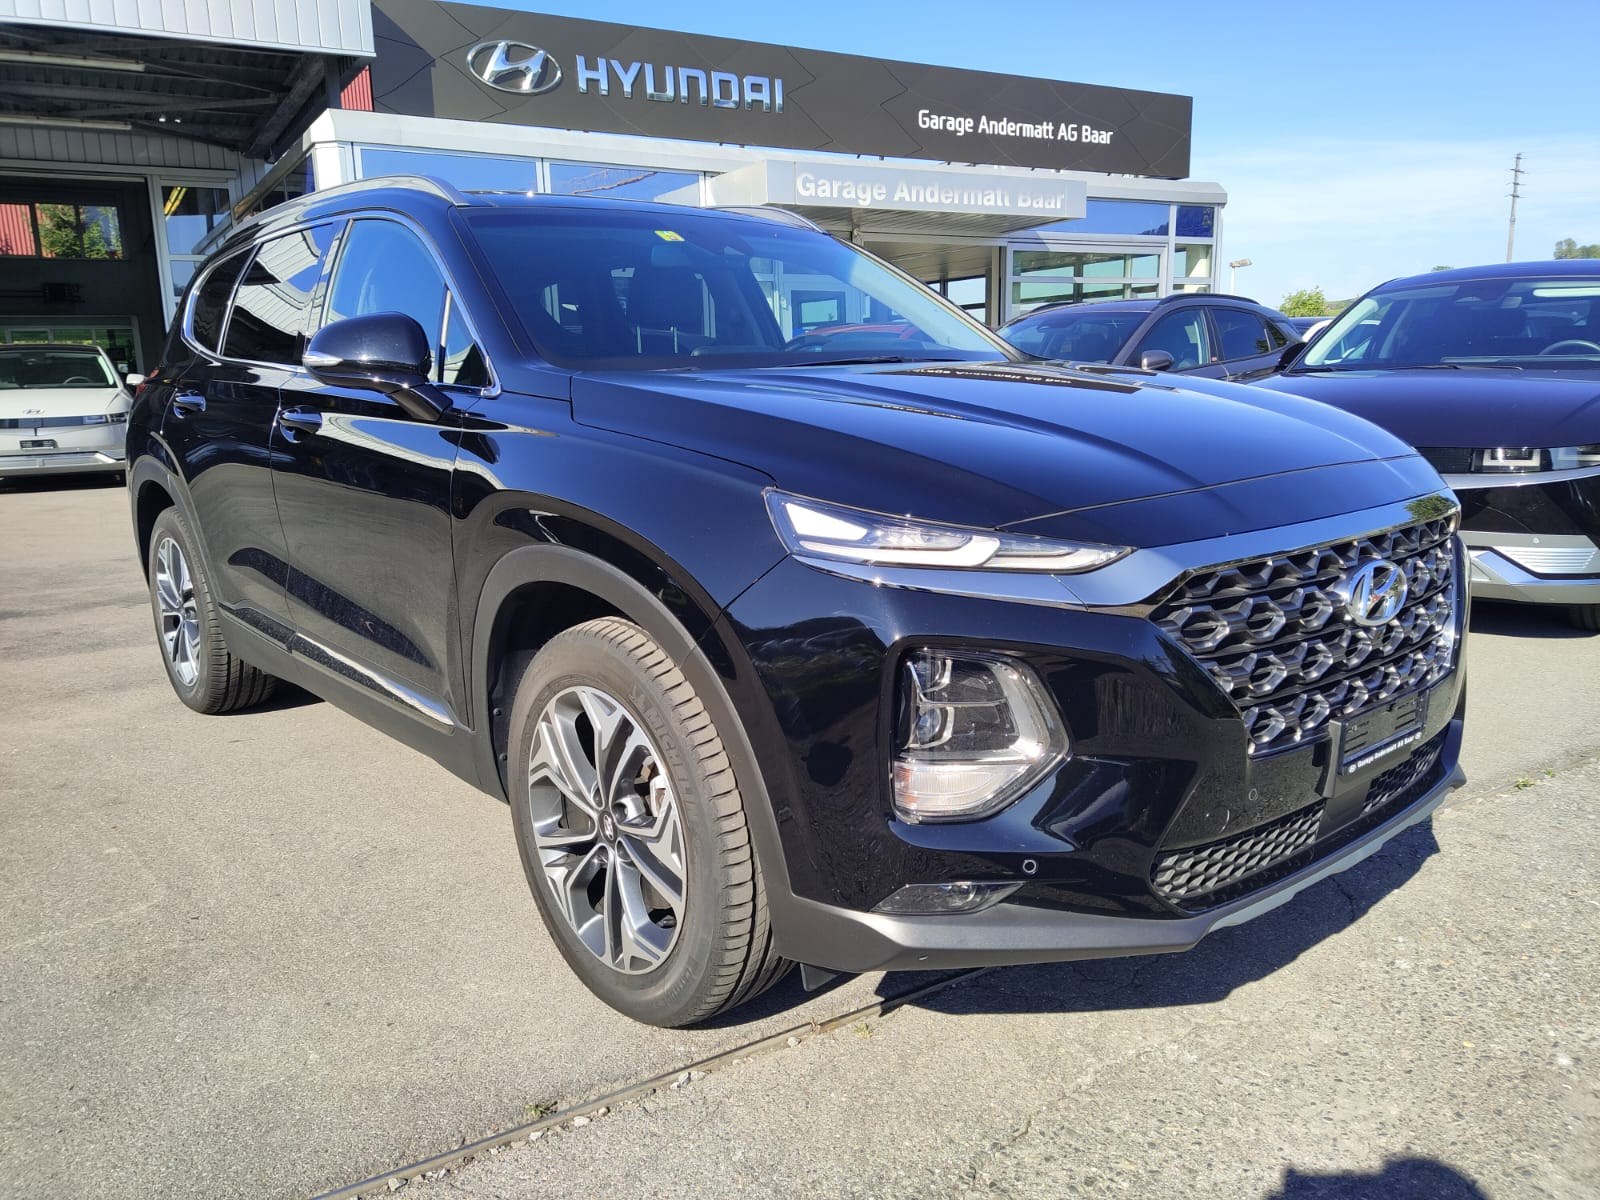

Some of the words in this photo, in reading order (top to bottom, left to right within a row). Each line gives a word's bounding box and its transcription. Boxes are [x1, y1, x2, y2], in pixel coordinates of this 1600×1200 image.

[576, 54, 784, 113] HYUNDAI
[918, 109, 974, 136] Garage
[978, 115, 1054, 140] Andermatt
[1057, 122, 1079, 142] AG
[1081, 124, 1114, 144] Baar
[796, 172, 887, 206] Garage
